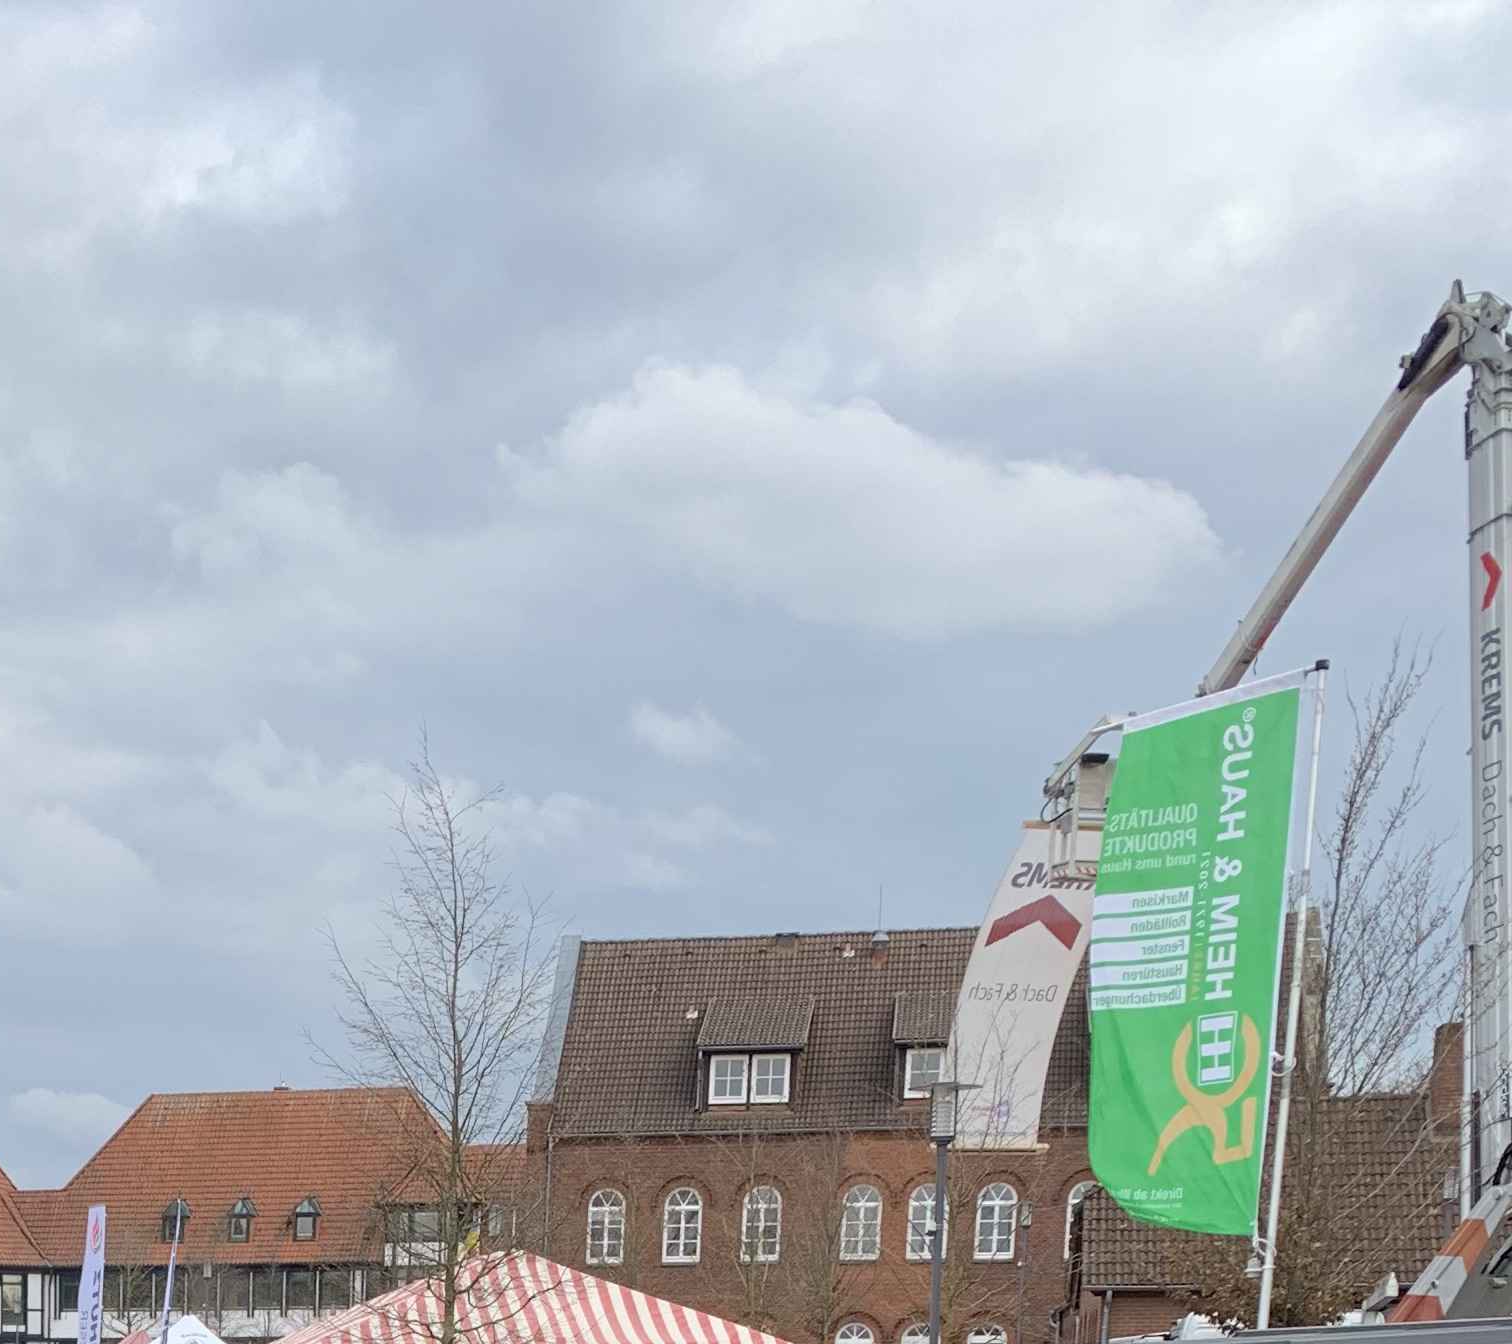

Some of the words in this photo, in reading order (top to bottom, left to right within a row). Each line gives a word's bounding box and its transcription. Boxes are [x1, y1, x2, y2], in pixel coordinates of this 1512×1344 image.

[1481, 628, 1502, 741] KREMS
[1482, 760, 1503, 835] Dach
[1486, 844, 1504, 869] &
[1483, 873, 1505, 944] Fach
